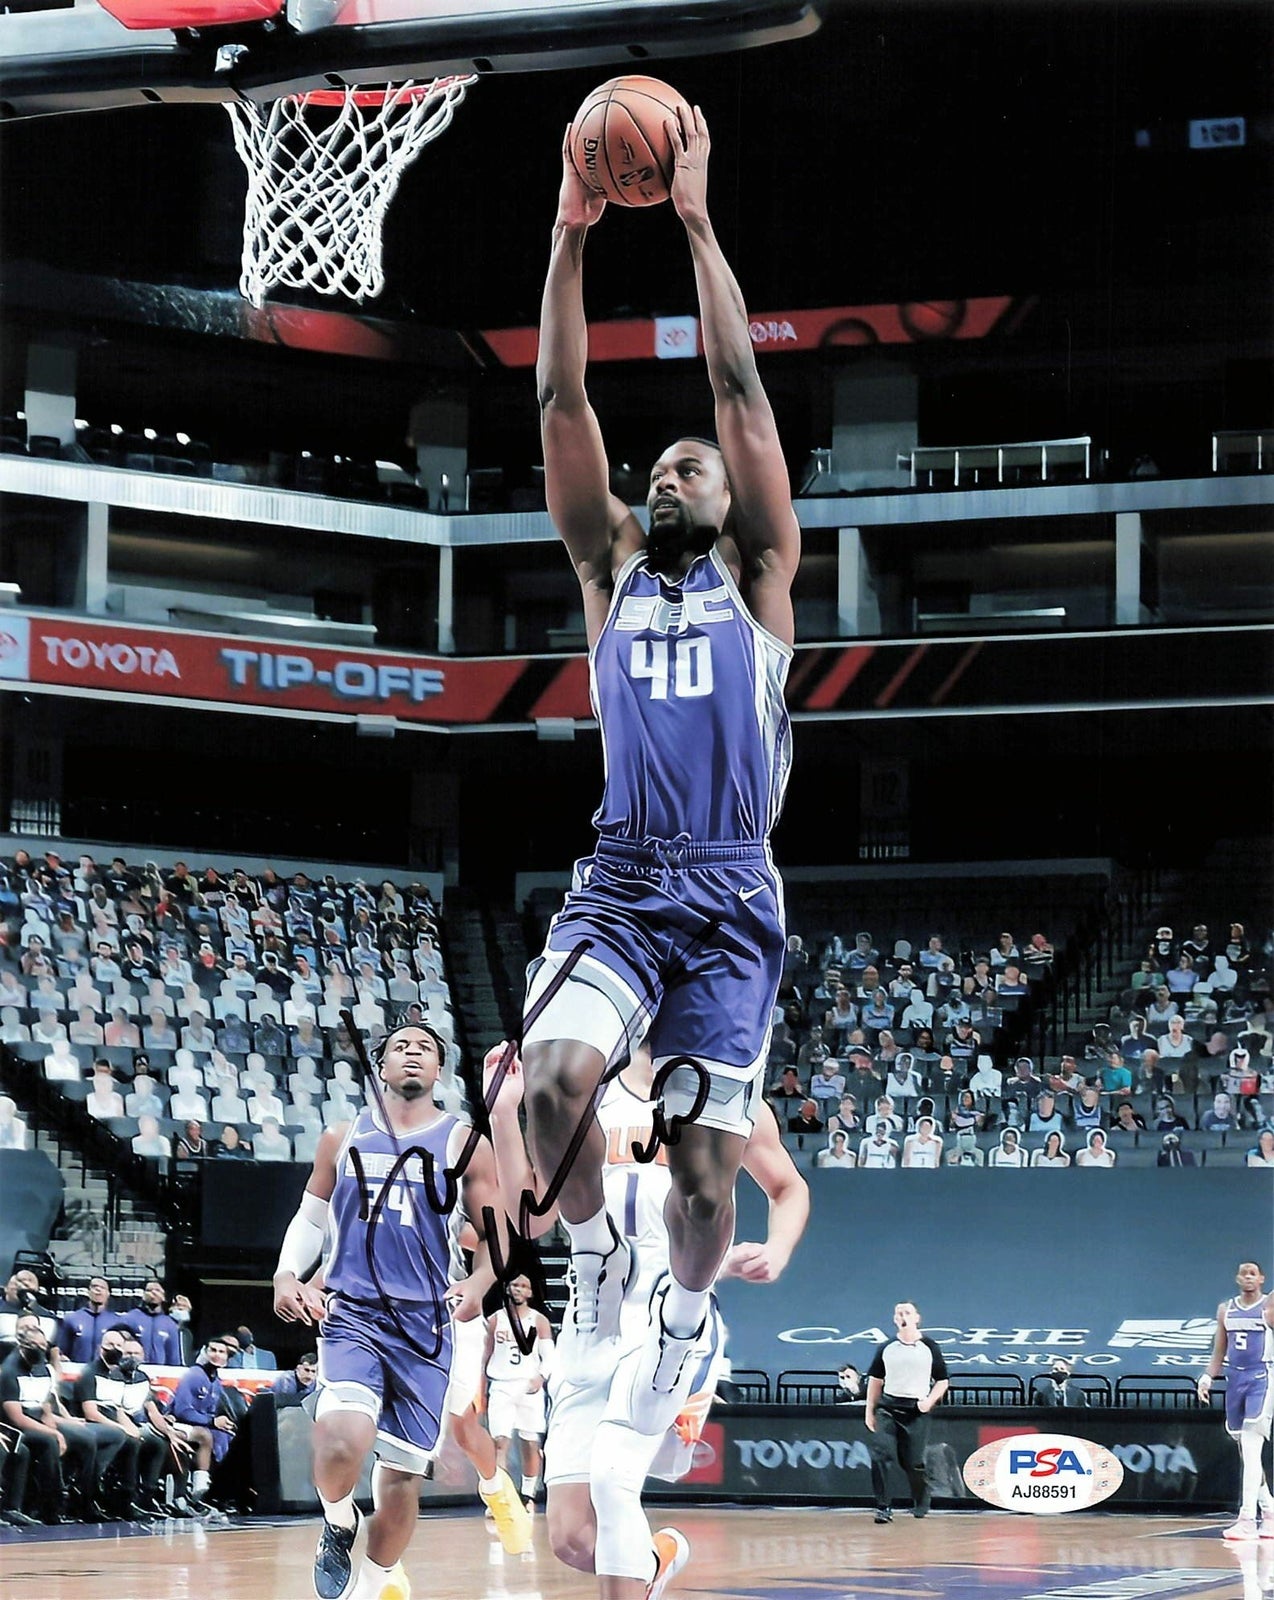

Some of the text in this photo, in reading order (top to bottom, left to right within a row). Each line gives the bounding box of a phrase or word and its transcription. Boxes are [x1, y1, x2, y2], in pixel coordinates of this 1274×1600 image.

[748, 321, 798, 343] OTA
[40, 636, 445, 701] TOYOTA TIP-OFF
[630, 635, 714, 700] 40
[624, 1172, 639, 1237] 1
[777, 1326, 1091, 1346] CACHE
[1234, 1331, 1248, 1350] 5
[509, 1345, 521, 1365] 3
[941, 1352, 1121, 1365] CASINO
[733, 1439, 873, 1470] TOYOTA
